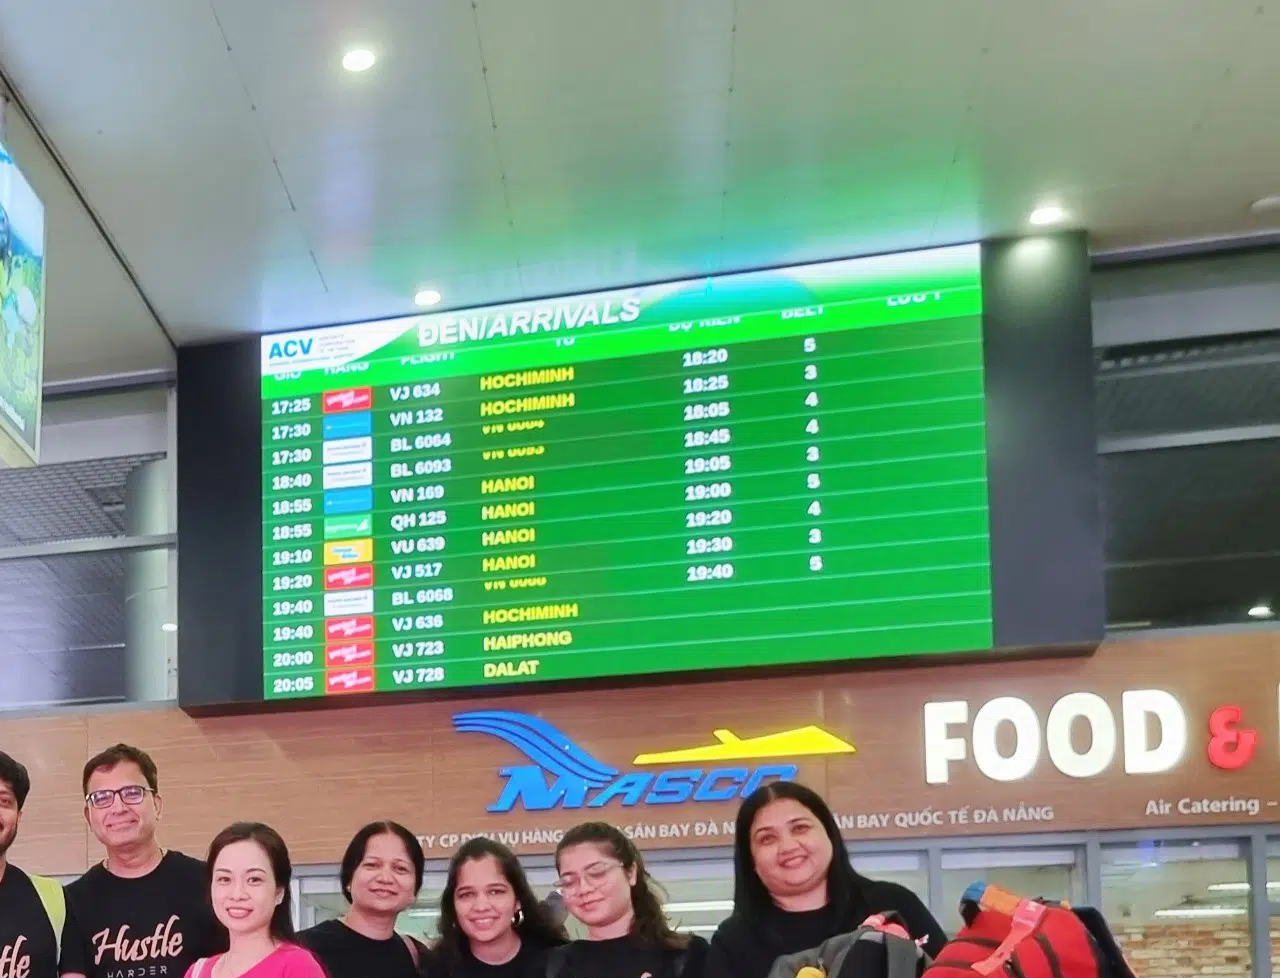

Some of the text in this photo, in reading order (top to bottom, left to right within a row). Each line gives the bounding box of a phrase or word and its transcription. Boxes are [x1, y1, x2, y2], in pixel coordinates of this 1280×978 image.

[269, 338, 313, 359] ACV
[272, 398, 311, 415] 17:25
[389, 386, 410, 401] VJ
[480, 367, 574, 391] HOCHIMINH
[272, 423, 311, 440] 17:30
[389, 411, 413, 426] VN
[480, 393, 575, 416] HOCHIMINH
[390, 437, 413, 452] BL
[390, 462, 414, 478] BL
[272, 498, 312, 515] 18:55
[390, 487, 414, 503] VN
[481, 475, 535, 494] HANOI
[272, 523, 312, 540] 18:55
[390, 513, 416, 532] QH
[481, 502, 535, 520] HANOI
[272, 549, 313, 566] 19:10
[390, 539, 415, 554] VU
[482, 528, 535, 546] HANOI
[273, 574, 313, 591] 19:20
[391, 565, 412, 580] VJ
[482, 554, 536, 572] HANOI
[273, 599, 313, 616] 19:40
[392, 591, 414, 606] BL
[273, 625, 314, 641] 19:40
[392, 617, 413, 631] VJ
[483, 603, 578, 624] HOCHIMINH
[273, 650, 314, 667] 20:00
[392, 642, 414, 658] VJ
[483, 630, 573, 651] HAIPHONG
[273, 676, 314, 693] 20:05
[392, 669, 414, 684] VJ
[483, 660, 540, 678] DALAT
[924, 689, 1187, 785] FOOD
[1208, 706, 1257, 770] &
[1145, 797, 1260, 816] Air Catering
[439, 834, 459, 848] CP
[522, 827, 564, 845] HÀNG
[659, 822, 690, 838] BAY
[857, 813, 890, 829] BAY
[894, 806, 944, 828] QUỐC
[91, 914, 184, 966] Hustle
